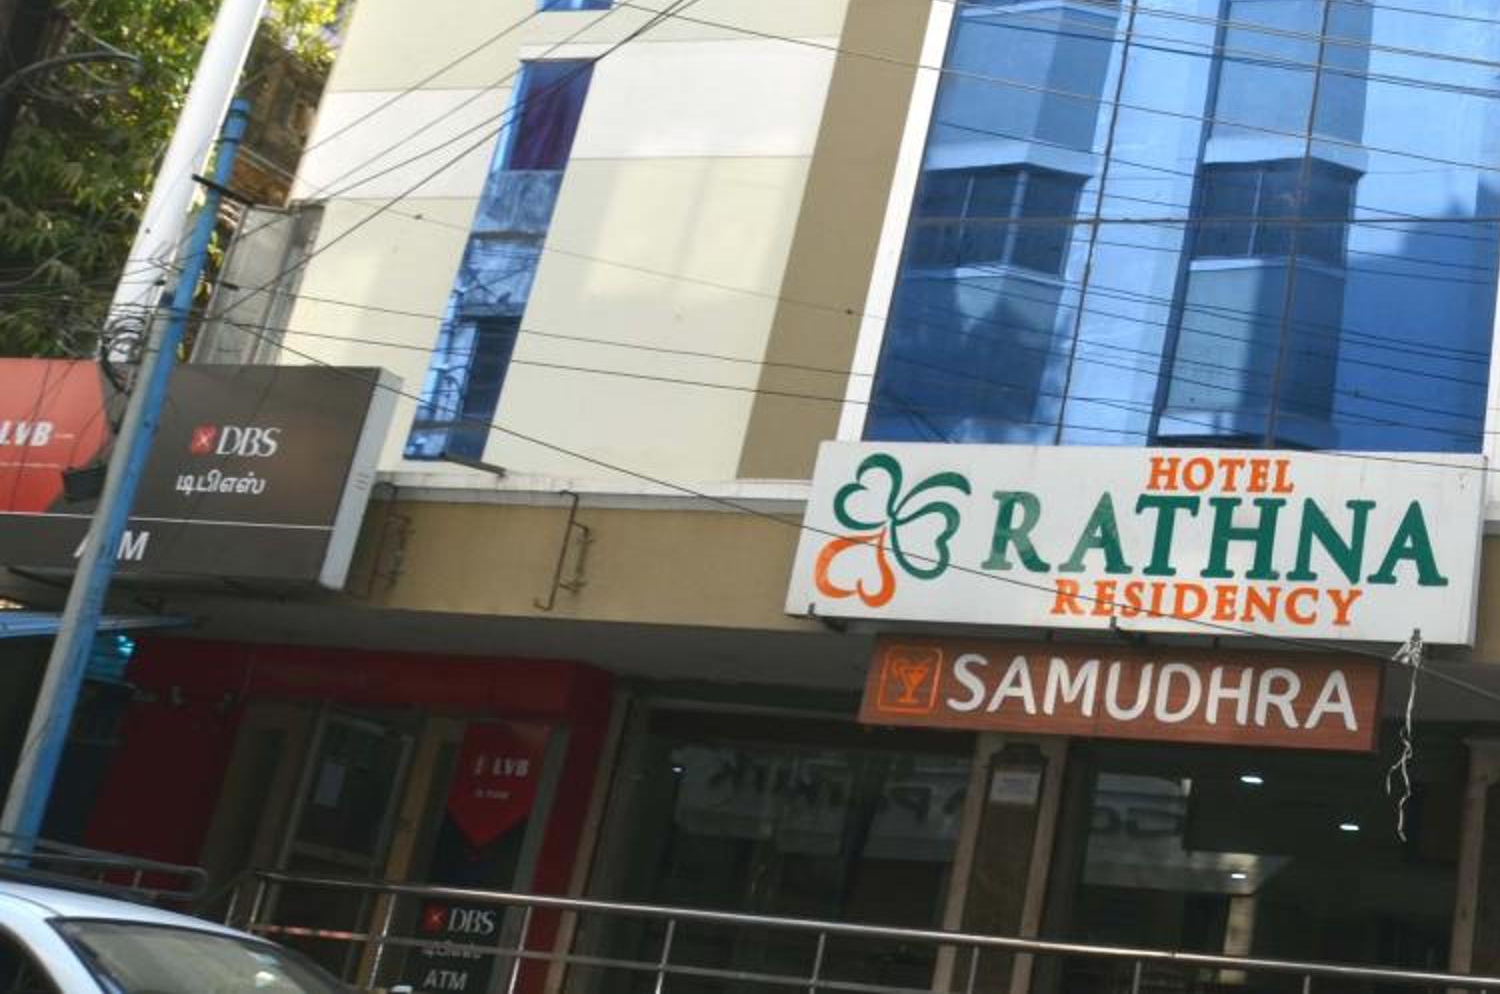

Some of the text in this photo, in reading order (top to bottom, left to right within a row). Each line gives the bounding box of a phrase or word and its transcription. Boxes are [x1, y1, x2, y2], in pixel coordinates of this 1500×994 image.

[0, 421, 53, 447] LVB
[215, 425, 282, 457] DBS
[175, 468, 267, 496] டிபிஎஸ்
[1145, 456, 1295, 494] HOTEL
[980, 490, 1449, 587] RATHNA
[1050, 579, 1363, 626] RESIDENCY
[947, 653, 1359, 732] SAMUDHRA
[447, 907, 496, 935] DBS
[422, 969, 467, 991] ATM
